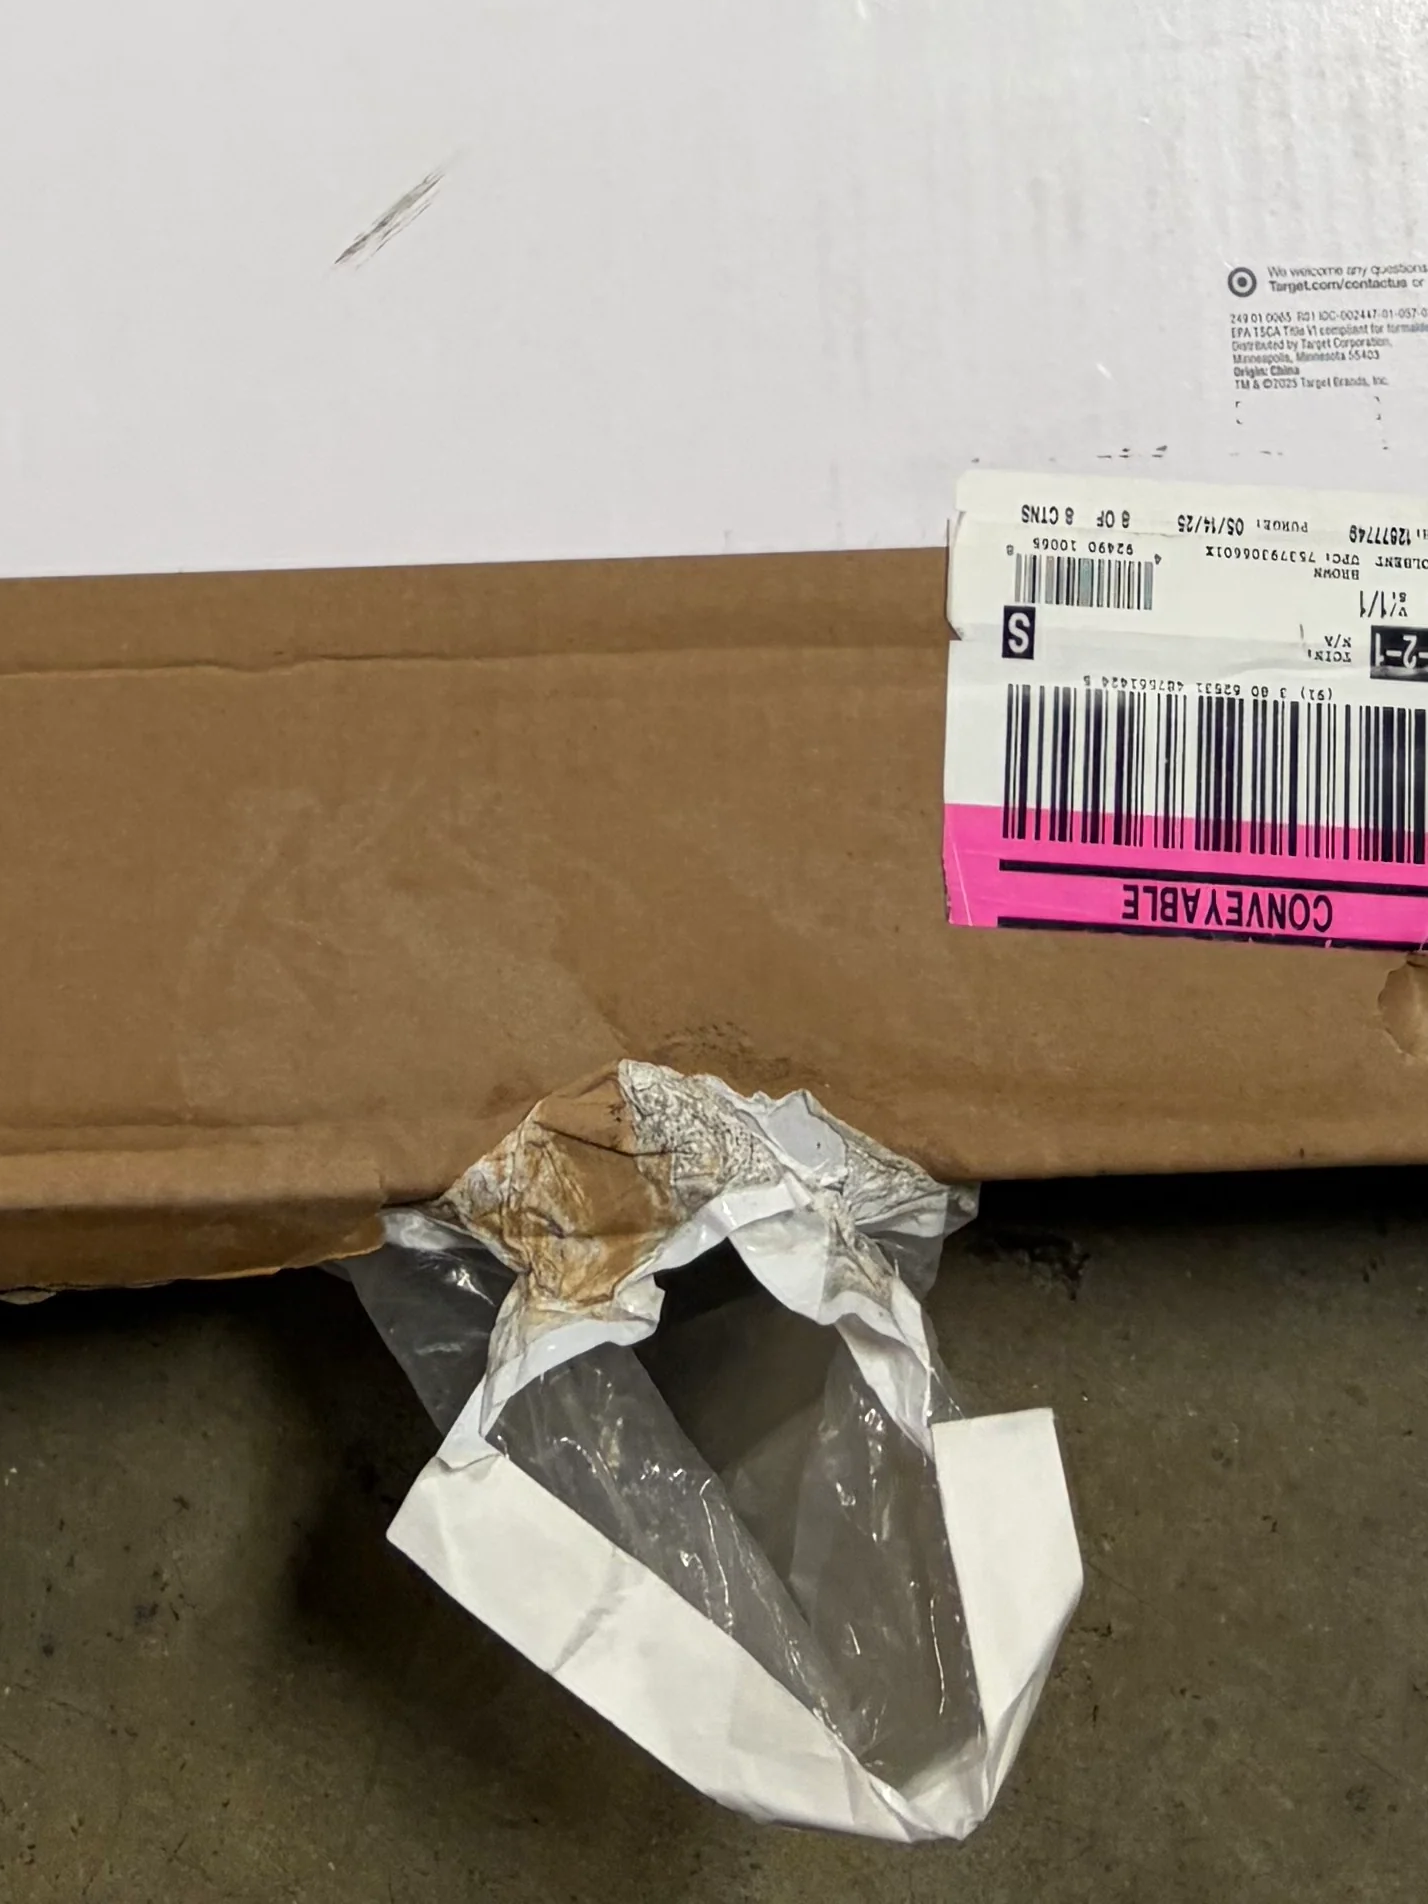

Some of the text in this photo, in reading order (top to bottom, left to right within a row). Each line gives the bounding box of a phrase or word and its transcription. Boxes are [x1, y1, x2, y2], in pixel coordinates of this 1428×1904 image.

[1289, 266, 1343, 277] welcome
[1347, 266, 1366, 278] any
[1371, 262, 1428, 277] questions
[1268, 277, 1407, 293] Target.com/contactus
[1412, 278, 1424, 288] or
[1231, 327, 1251, 338] EPA
[1319, 324, 1367, 336] compliant
[1370, 323, 1383, 333] for
[1231, 339, 1284, 351] Distributed
[1286, 339, 1298, 351] by
[1301, 337, 1331, 350] Target
[1270, 365, 1300, 376] China
[1235, 379, 1250, 389] TM
[1301, 377, 1331, 389] Target
[1022, 504, 1059, 525] CTNS
[1096, 510, 1115, 528] OF
[1177, 514, 1244, 536] 05/14/25
[1088, 541, 1134, 555] 92490
[1313, 567, 1359, 580] BROWN
[1007, 612, 1030, 654] S
[1280, 688, 1287, 698] 3
[1301, 687, 1333, 700] (91)
[1122, 883, 1333, 930] CONVEYABLE
